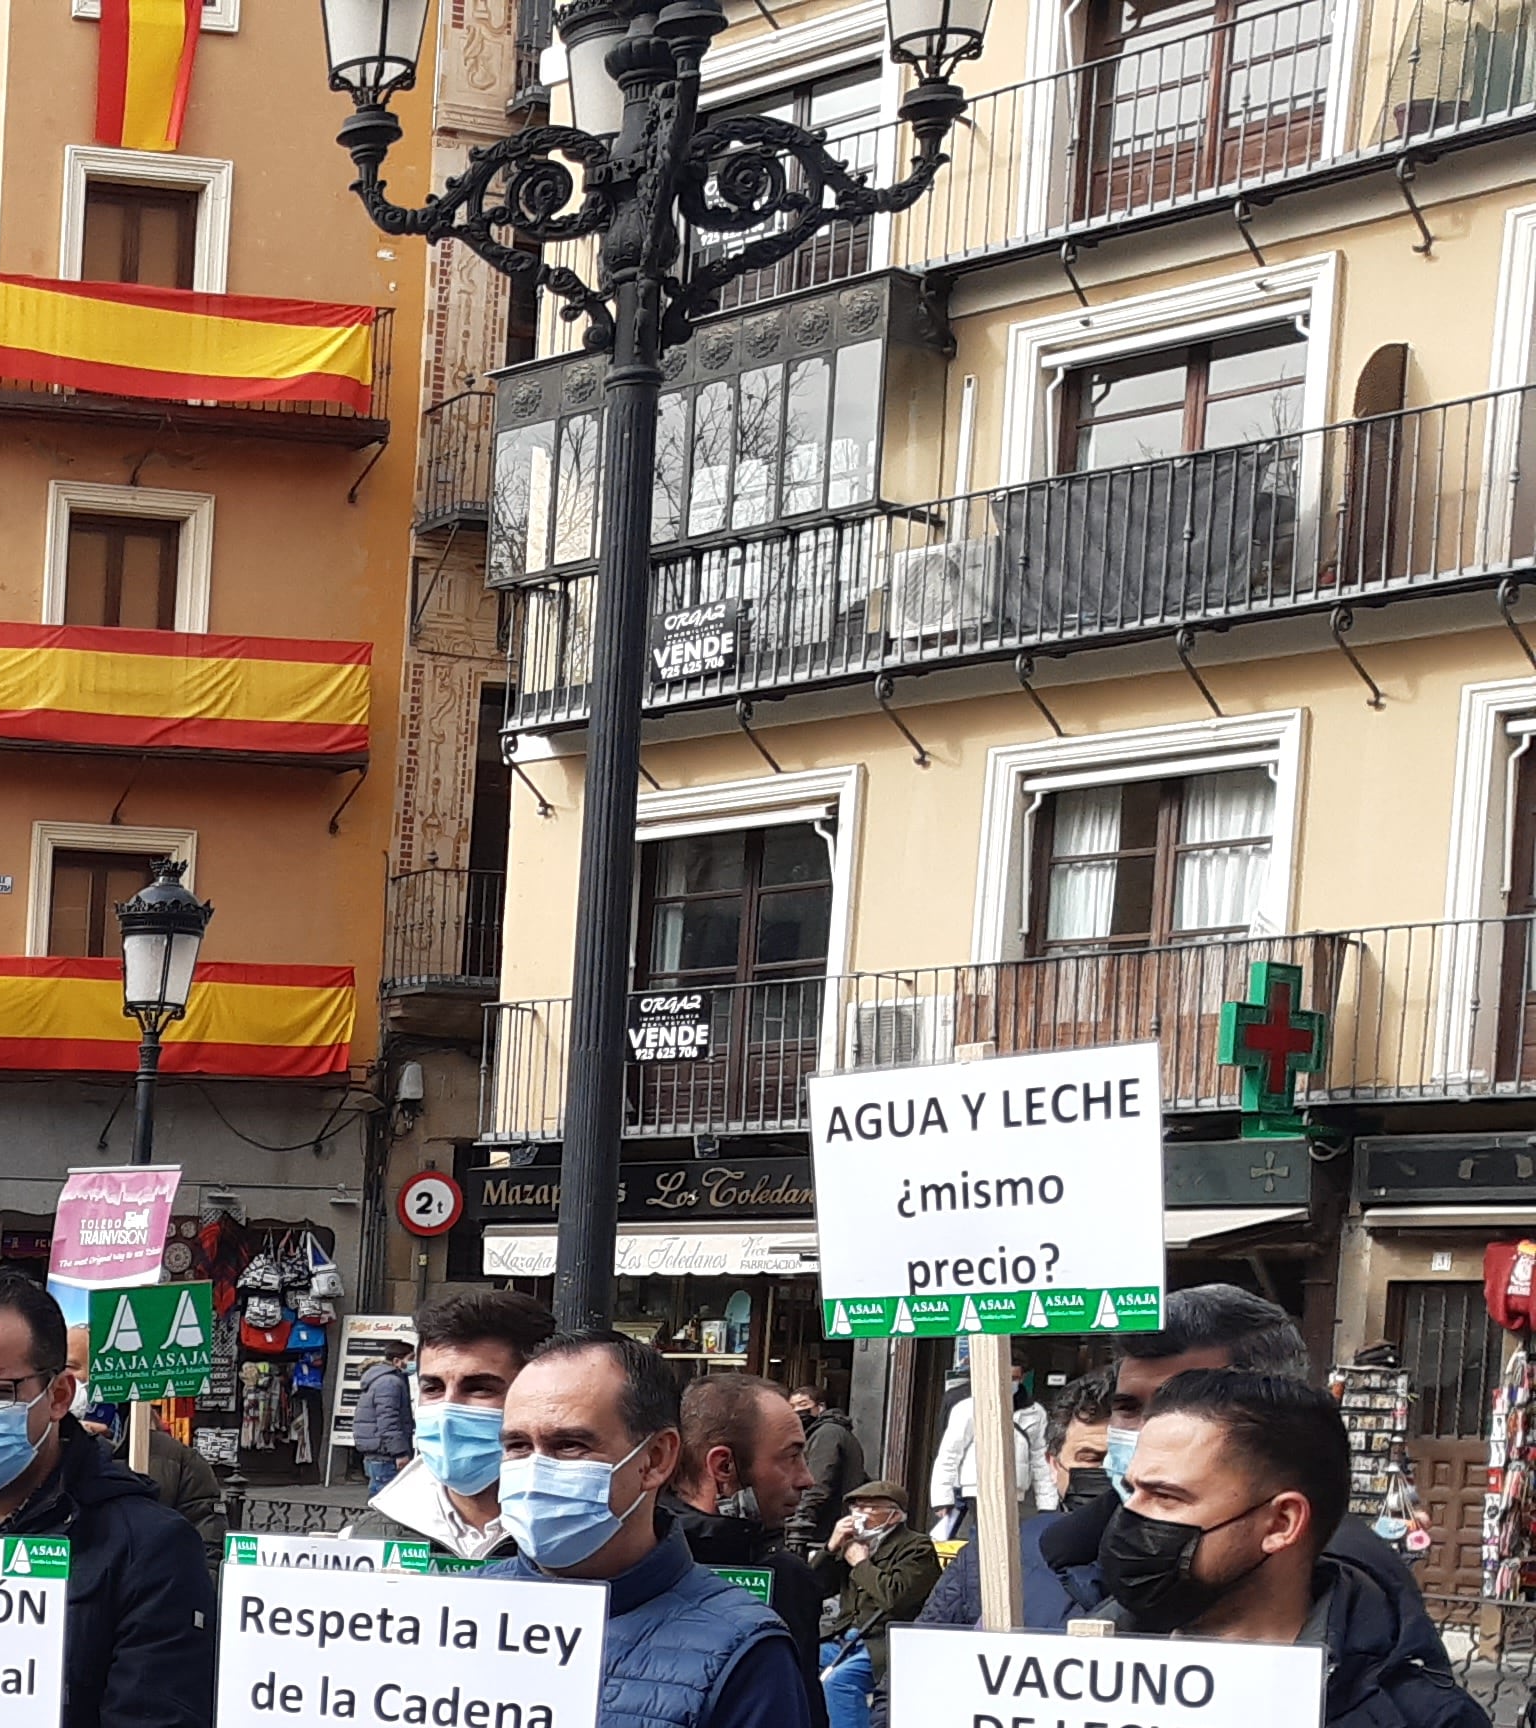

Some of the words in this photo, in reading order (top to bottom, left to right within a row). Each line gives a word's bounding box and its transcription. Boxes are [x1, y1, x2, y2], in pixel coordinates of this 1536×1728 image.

[653, 632, 733, 668] VENDE
[661, 666, 680, 679] 925
[682, 660, 701, 674] 625
[705, 655, 724, 669] 706
[628, 1025, 709, 1048] VENDE
[635, 1048, 655, 1060] 925
[656, 1047, 676, 1059] 625
[679, 1046, 697, 1057] 706
[826, 1097, 948, 1143] AGUA
[962, 1092, 986, 1131] Y
[1003, 1078, 1140, 1128] LECHE
[415, 1191, 433, 1214] 2
[437, 1199, 444, 1214] t
[646, 1171, 699, 1209] Los
[897, 1171, 1064, 1218] ¿mismo
[80, 1230, 148, 1246] TRAINVISION
[81, 1219, 121, 1229] TOLEDO
[617, 1237, 641, 1269] Los
[648, 1237, 727, 1270] Toledanos
[908, 1243, 1059, 1295] precio?
[91, 1355, 149, 1372] ASAJA
[153, 1350, 209, 1368] ASAJA
[240, 1595, 421, 1648] Respeta
[439, 1606, 478, 1649] la
[498, 1612, 582, 1666] Ley
[1, 1659, 36, 1695] al
[976, 1654, 1215, 1709] VACUNO
[250, 1671, 303, 1714] de
[320, 1676, 356, 1719] la
